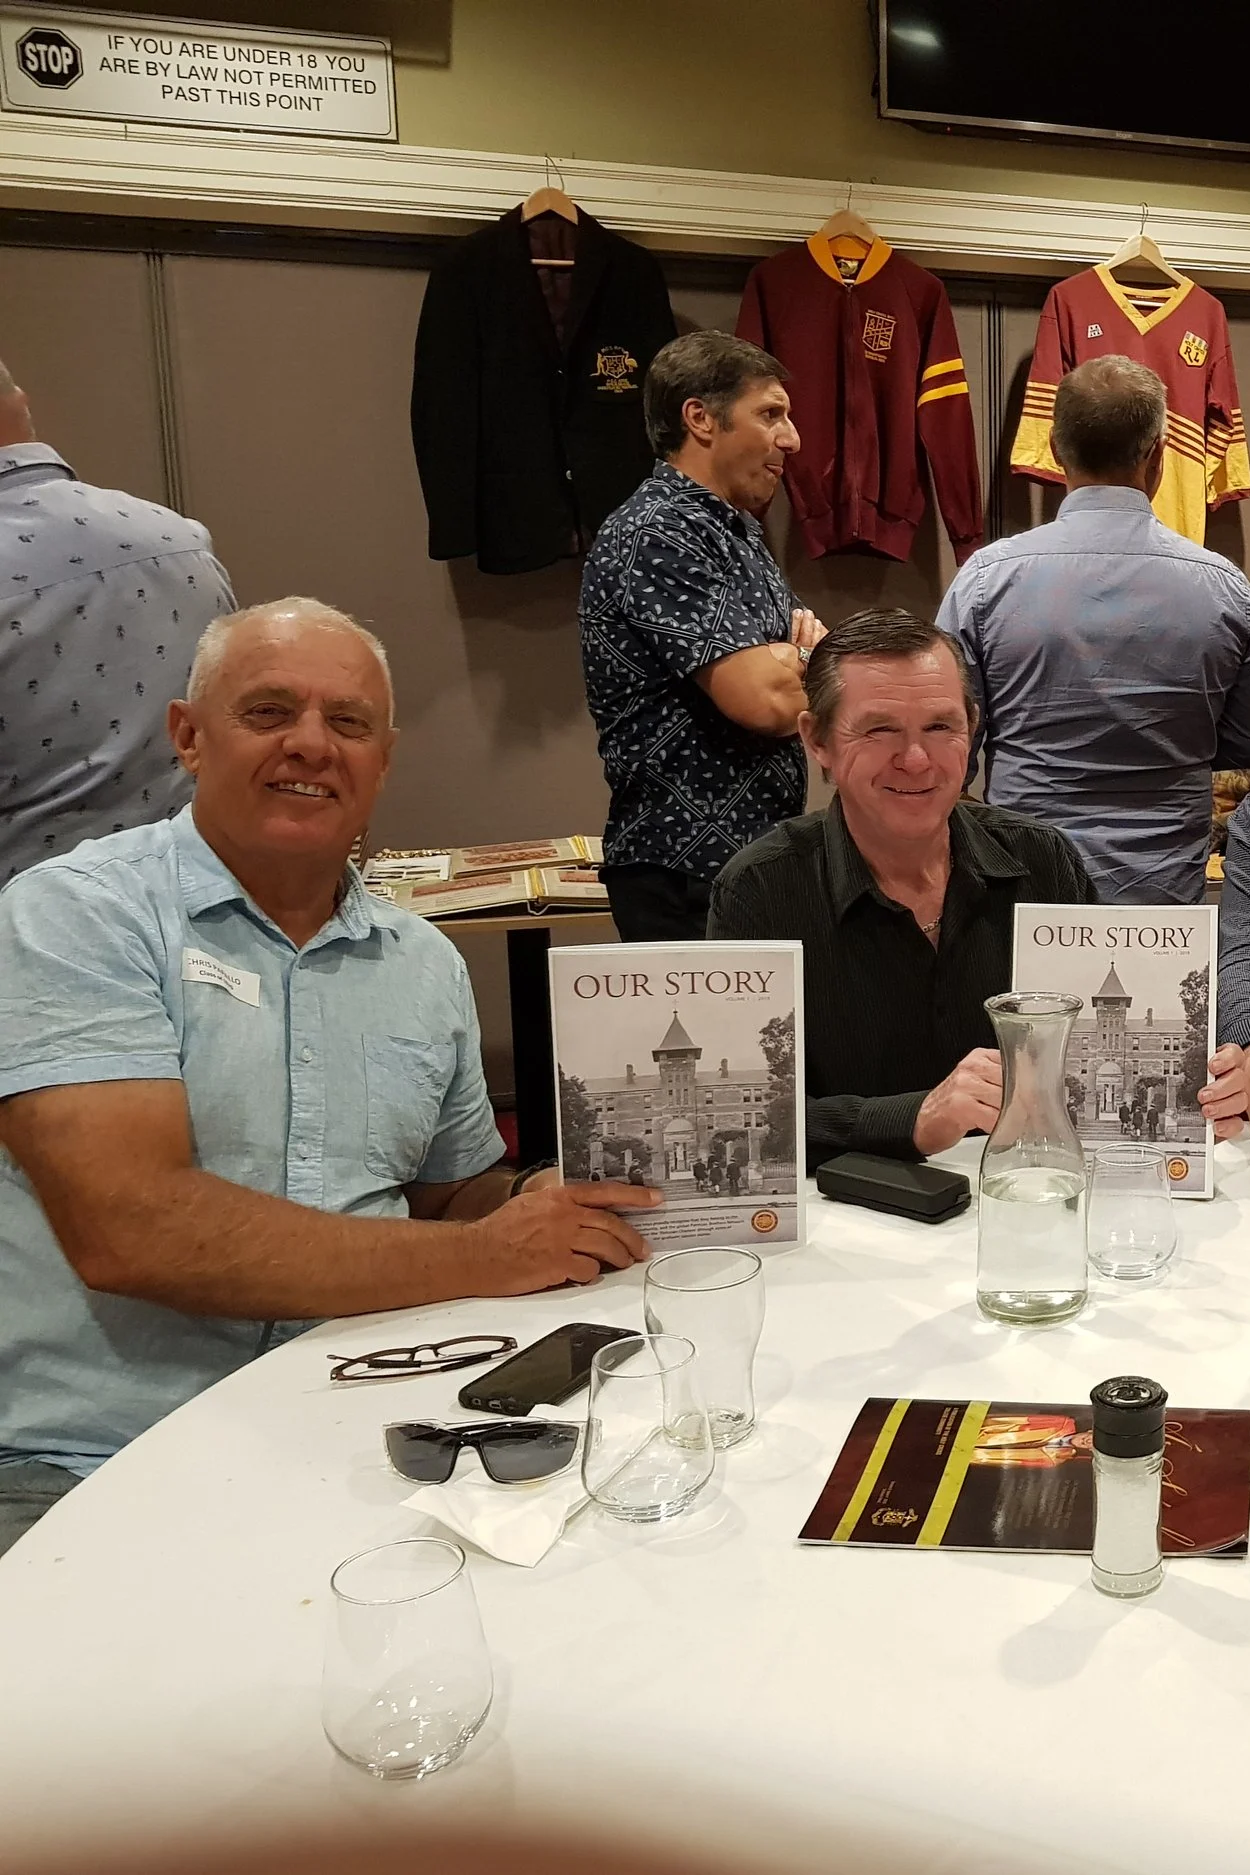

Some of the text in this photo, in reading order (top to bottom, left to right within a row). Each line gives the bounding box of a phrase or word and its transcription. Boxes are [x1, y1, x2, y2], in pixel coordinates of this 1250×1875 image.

[24, 43, 73, 76] STOP
[107, 34, 366, 73] IF YOU ARE UNDER 18 YOU
[99, 56, 376, 95] ARE BY LAW NOT PERMITTED
[162, 84, 324, 112] PAST THIS POINT
[1033, 925, 1195, 949] OUR STORY
[573, 970, 776, 999] OUR STORY
